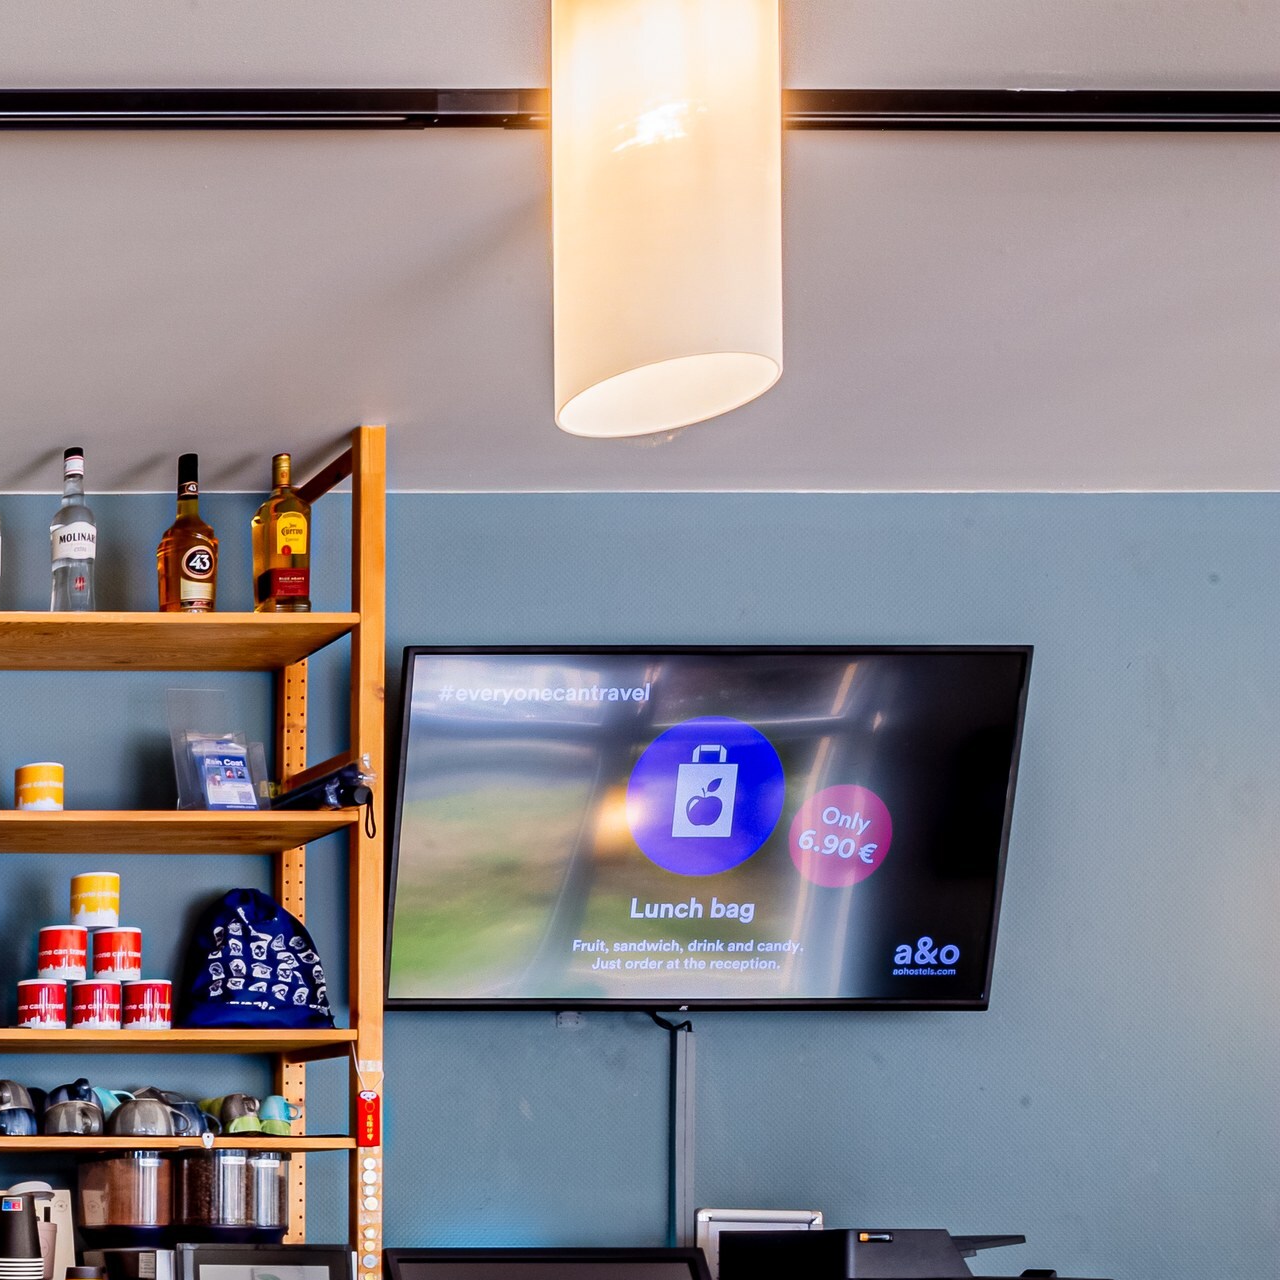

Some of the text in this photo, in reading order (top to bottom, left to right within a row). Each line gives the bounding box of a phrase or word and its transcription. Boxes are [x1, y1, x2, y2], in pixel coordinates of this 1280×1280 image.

[59, 533, 96, 544] MOLINAR
[189, 555, 210, 570] 43
[439, 683, 651, 705] #everyonecantravel
[821, 806, 870, 836] Only
[630, 897, 755, 923] Lunch bag
[572, 939, 804, 955] Fruit, sandwich, drink and candy.
[893, 936, 960, 965] a&o
[592, 957, 781, 972] Just order at the reception.
[892, 967, 957, 977] aohostels.com
